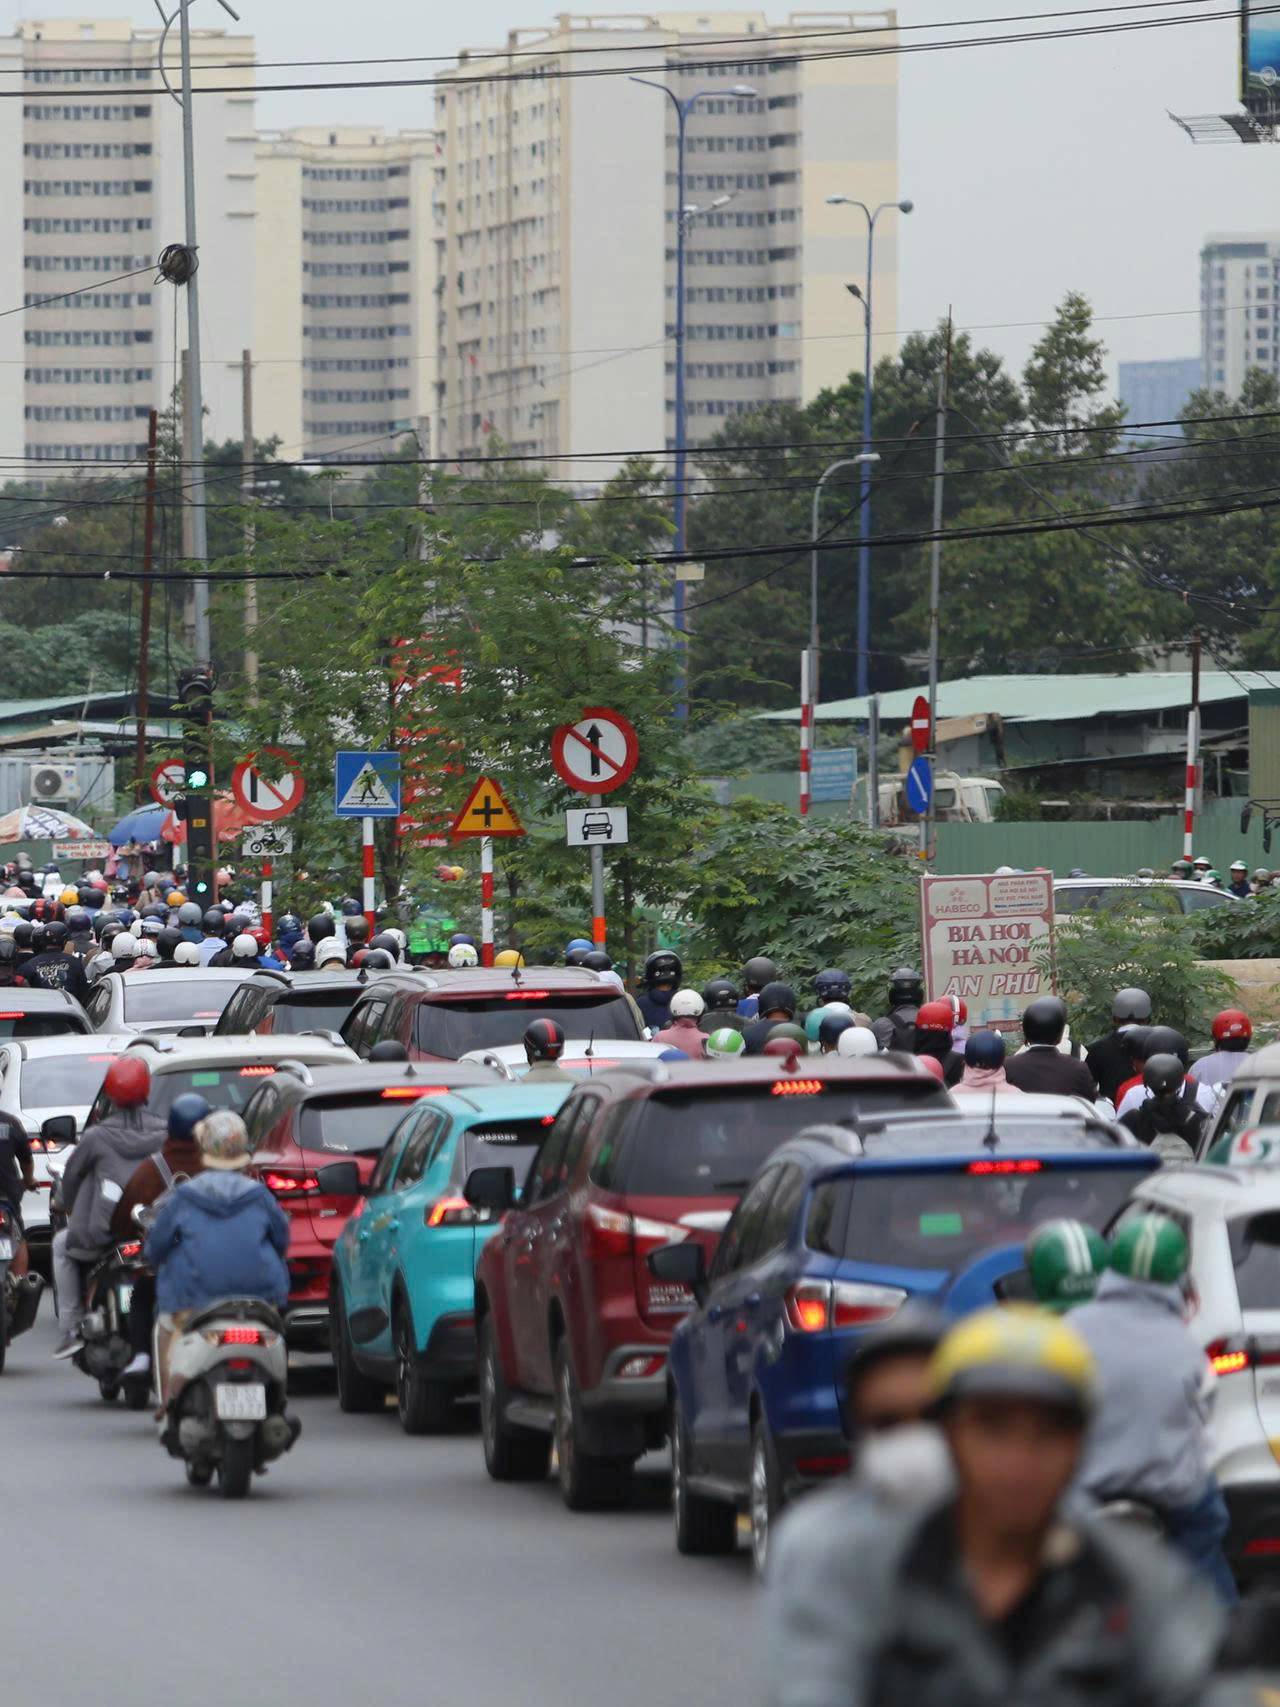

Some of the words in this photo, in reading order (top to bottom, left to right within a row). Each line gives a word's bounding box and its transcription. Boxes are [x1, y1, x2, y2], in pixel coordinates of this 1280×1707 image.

[935, 904, 980, 914] HABECO
[947, 924, 987, 943] BIA
[989, 922, 1032, 941] HƠI
[951, 944, 987, 966] HÀ
[988, 943, 1032, 967] NỘI
[943, 975, 984, 997] AN
[989, 967, 1041, 996] PHÚ
